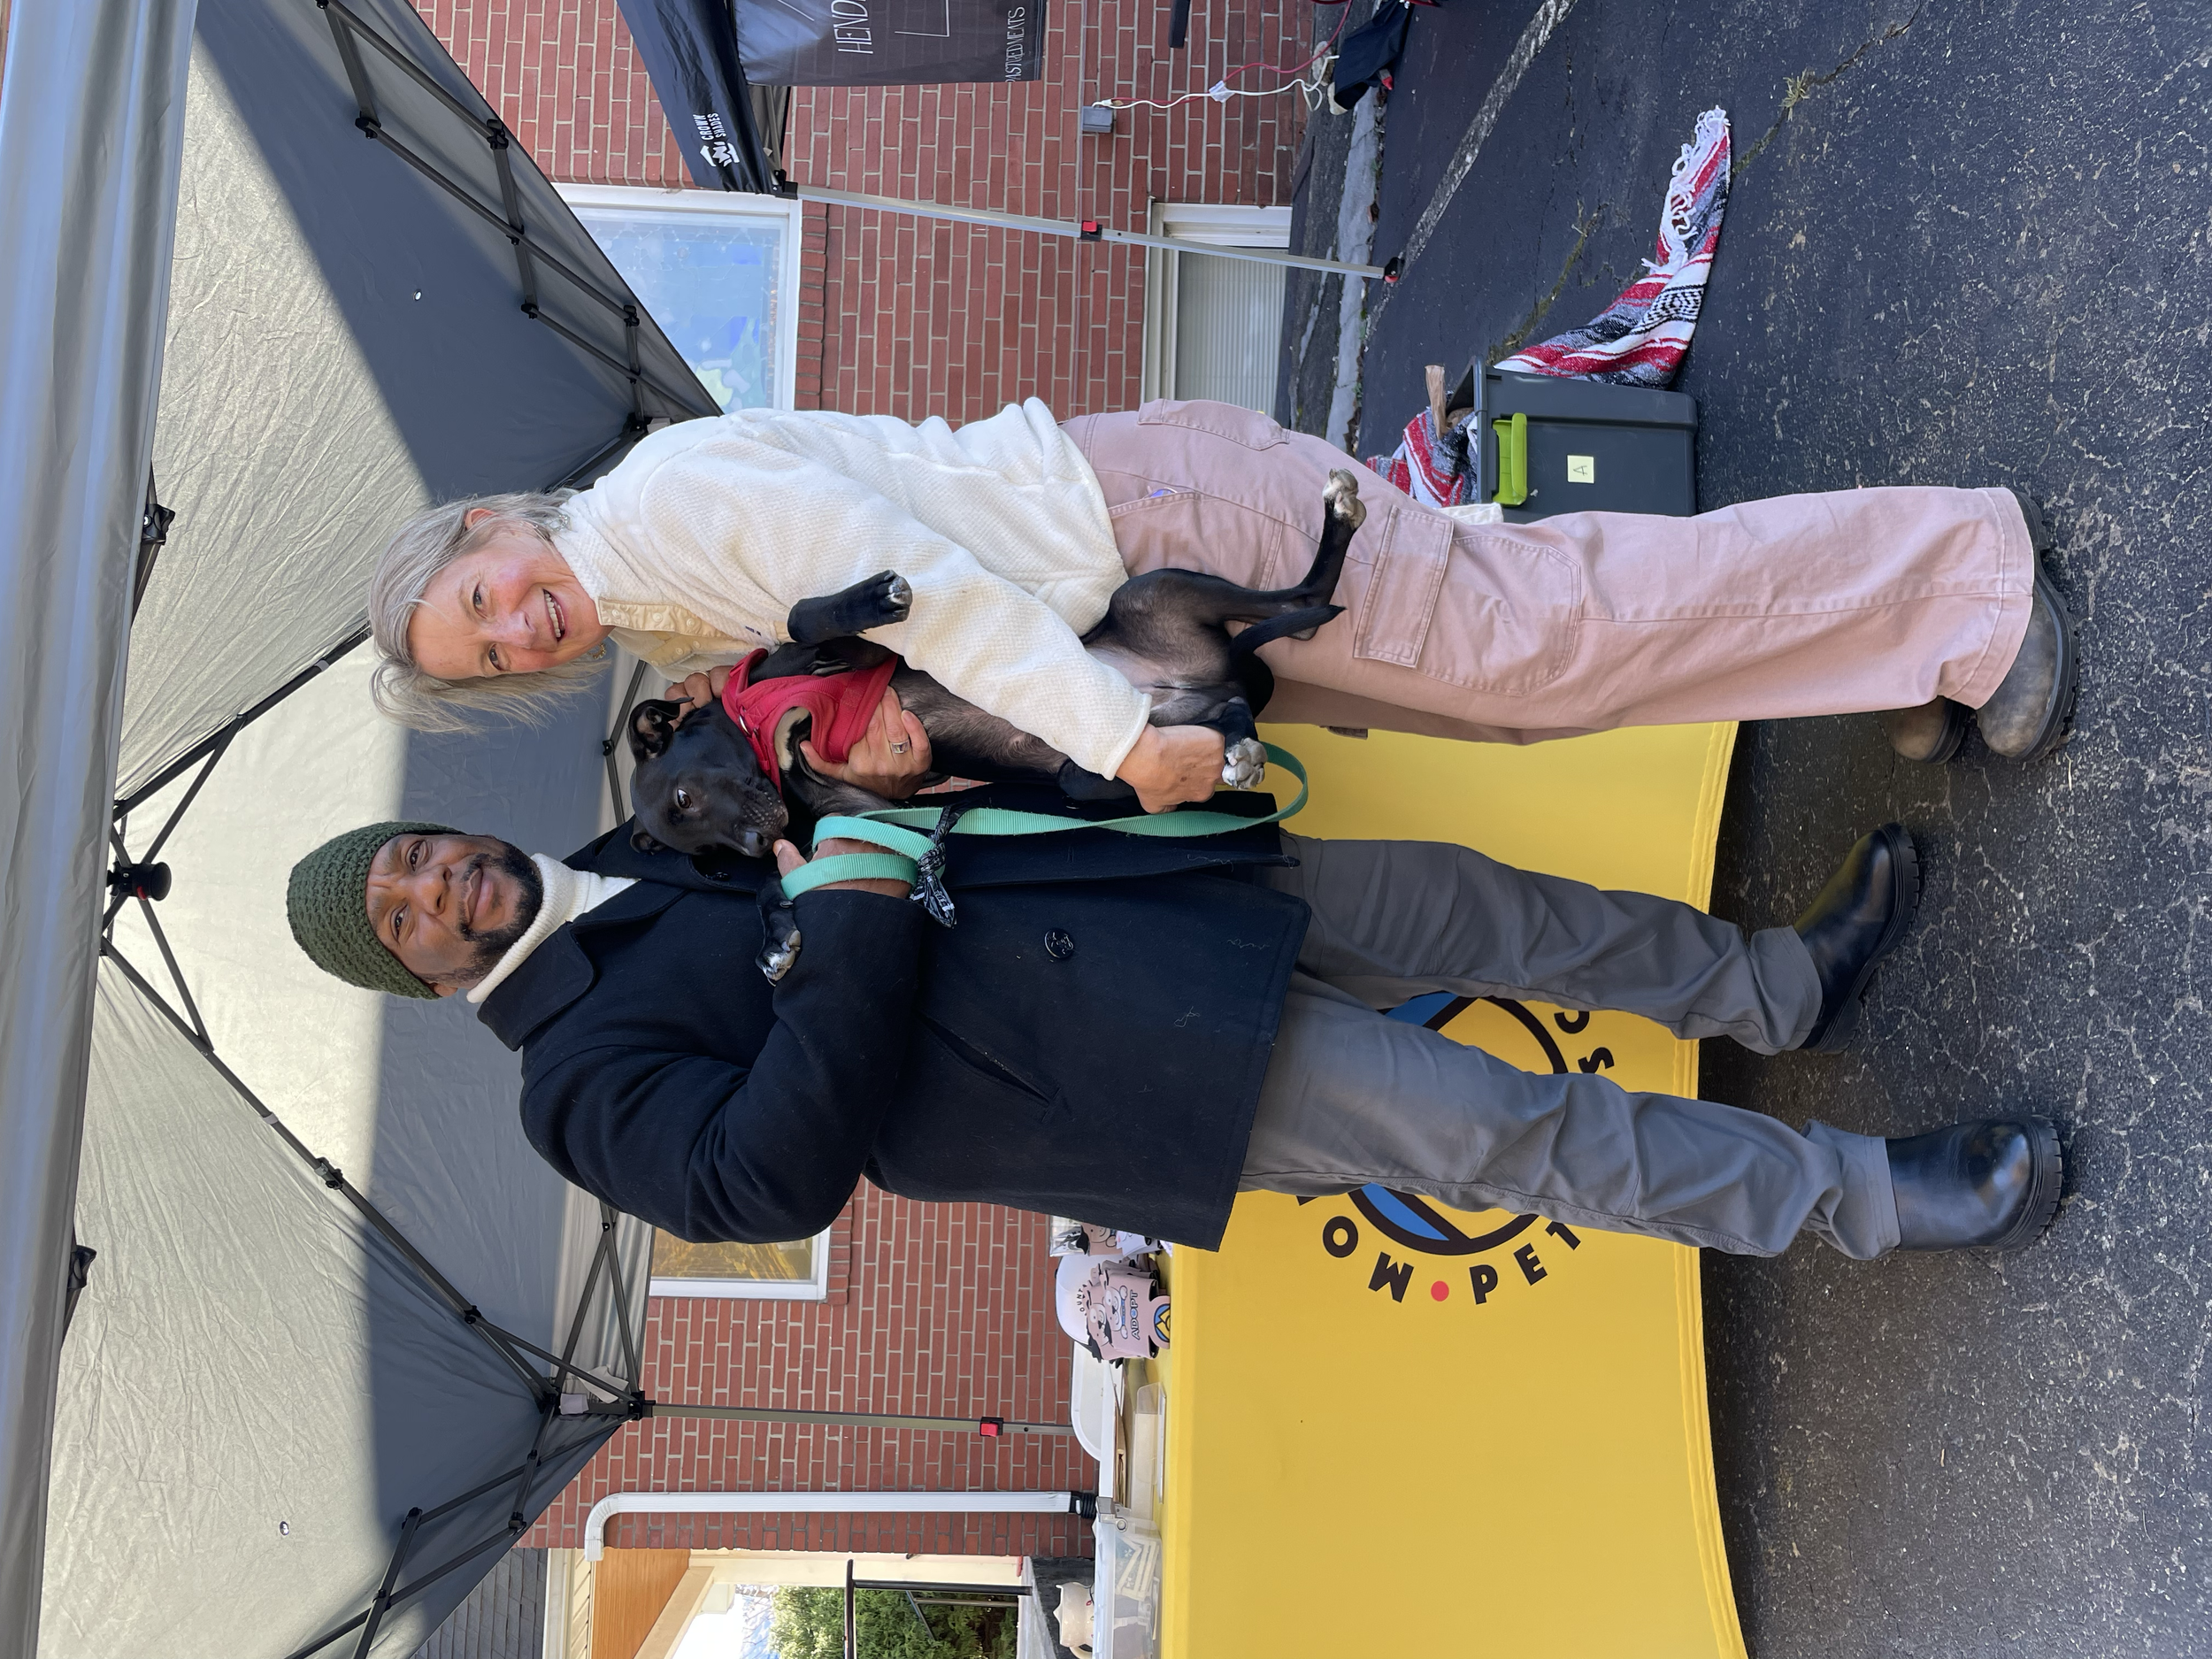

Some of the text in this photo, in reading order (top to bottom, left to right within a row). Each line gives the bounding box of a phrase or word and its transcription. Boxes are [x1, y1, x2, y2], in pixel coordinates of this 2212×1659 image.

[831, 0, 874, 54] HEND
[692, 114, 714, 141] CROWN
[707, 112, 726, 138] SHADES
[1572, 465, 1588, 476] A
[1129, 1289, 1141, 1340] ADOPT
